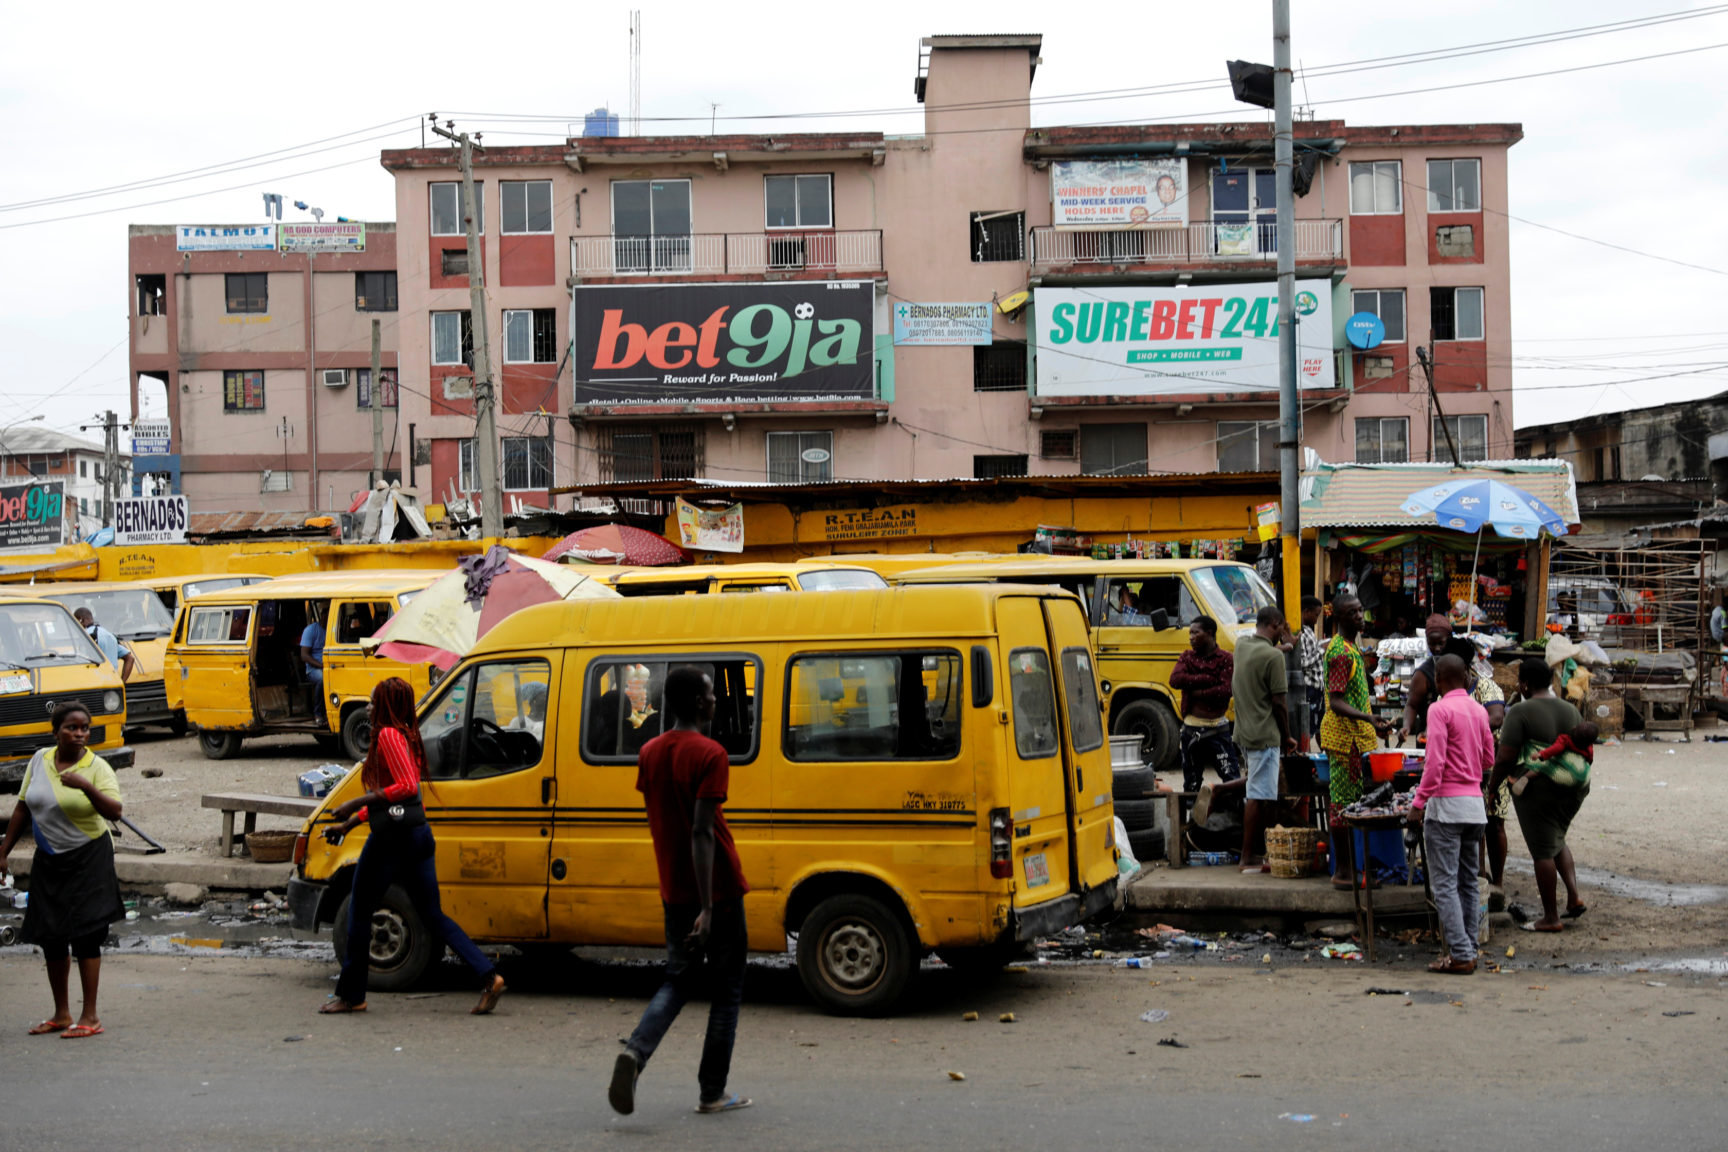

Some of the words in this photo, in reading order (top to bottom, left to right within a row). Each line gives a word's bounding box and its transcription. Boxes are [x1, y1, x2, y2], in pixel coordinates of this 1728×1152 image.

[1110, 185, 1147, 196] CHAPEL
[1108, 196, 1146, 205] SERVICE
[1065, 207, 1096, 216] HOLDS
[1100, 206, 1124, 215] HERE
[314, 225, 361, 234] COMPUTERS
[910, 306, 941, 318] BERNADOS
[943, 305, 975, 318] PHARMACY
[592, 302, 861, 378] bet9ja
[1170, 351, 1200, 359] MOBILE
[1213, 350, 1231, 358] WEB
[663, 374, 706, 384] Reward
[708, 374, 725, 385] for
[729, 372, 777, 384] Passion!
[116, 498, 185, 533] BERNADOS
[826, 509, 916, 525] R.T.E.A.N
[900, 519, 916, 527] PARK
[127, 532, 159, 542] PHARMACY
[160, 531, 172, 541] LTD.
[881, 528, 908, 537] ZONE
